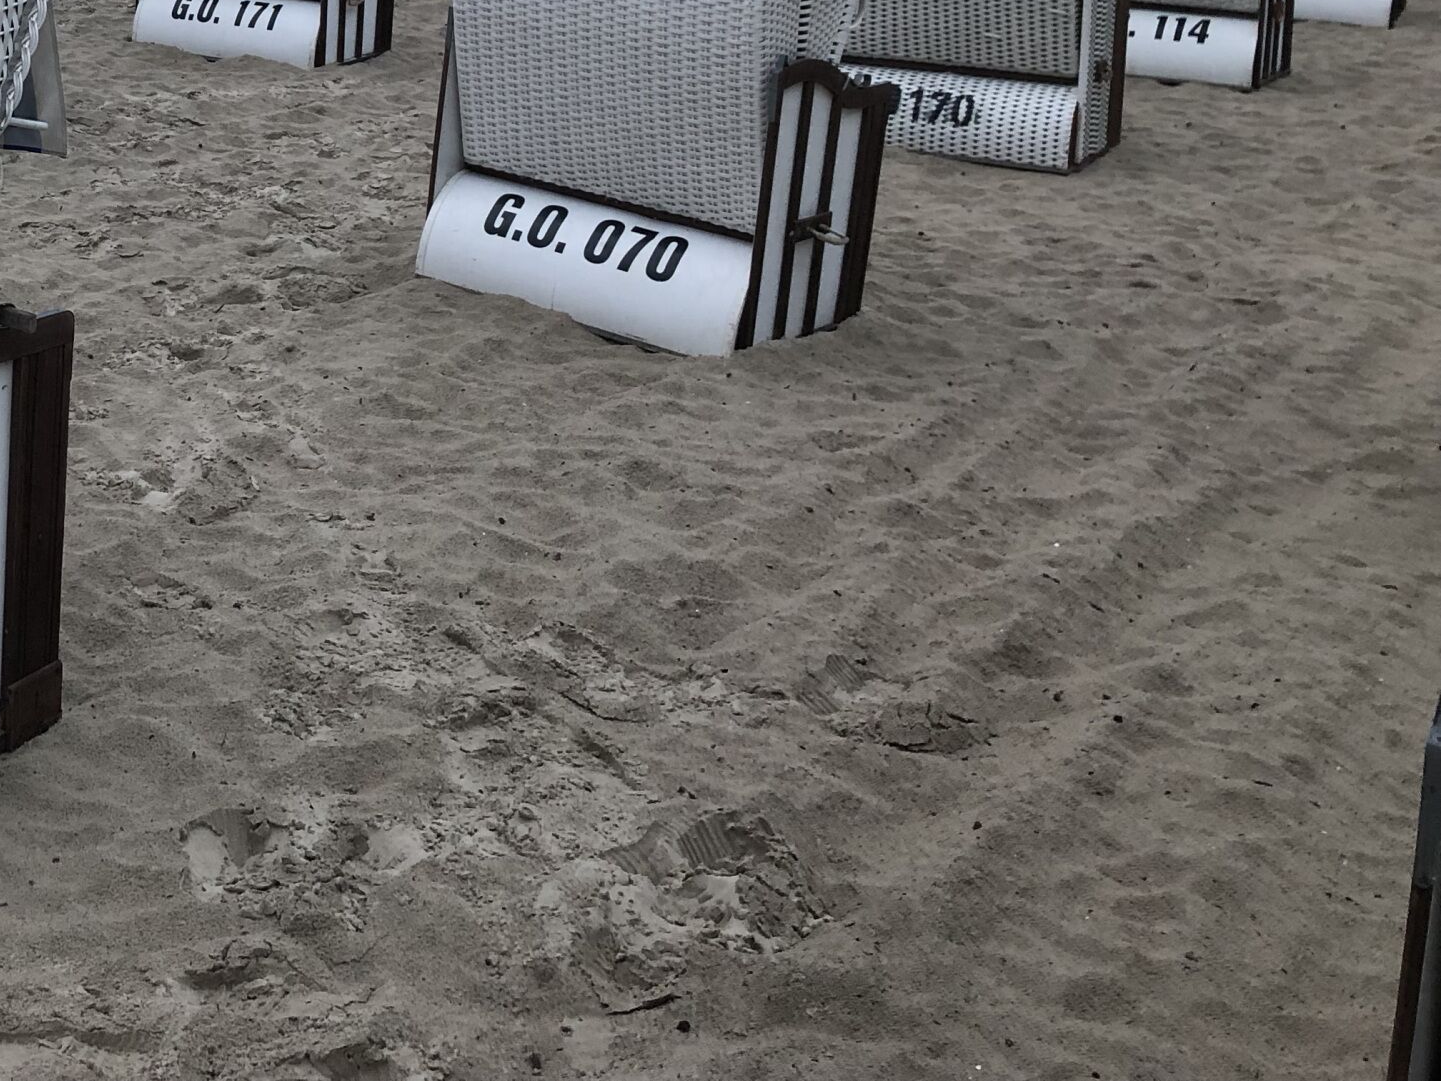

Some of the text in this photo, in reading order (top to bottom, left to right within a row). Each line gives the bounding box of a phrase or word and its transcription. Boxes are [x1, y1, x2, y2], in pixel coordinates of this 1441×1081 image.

[234, 0, 283, 31] 171
[1154, 15, 1211, 45] 114
[910, 86, 975, 128] 170
[483, 193, 689, 282] G.O. 070
